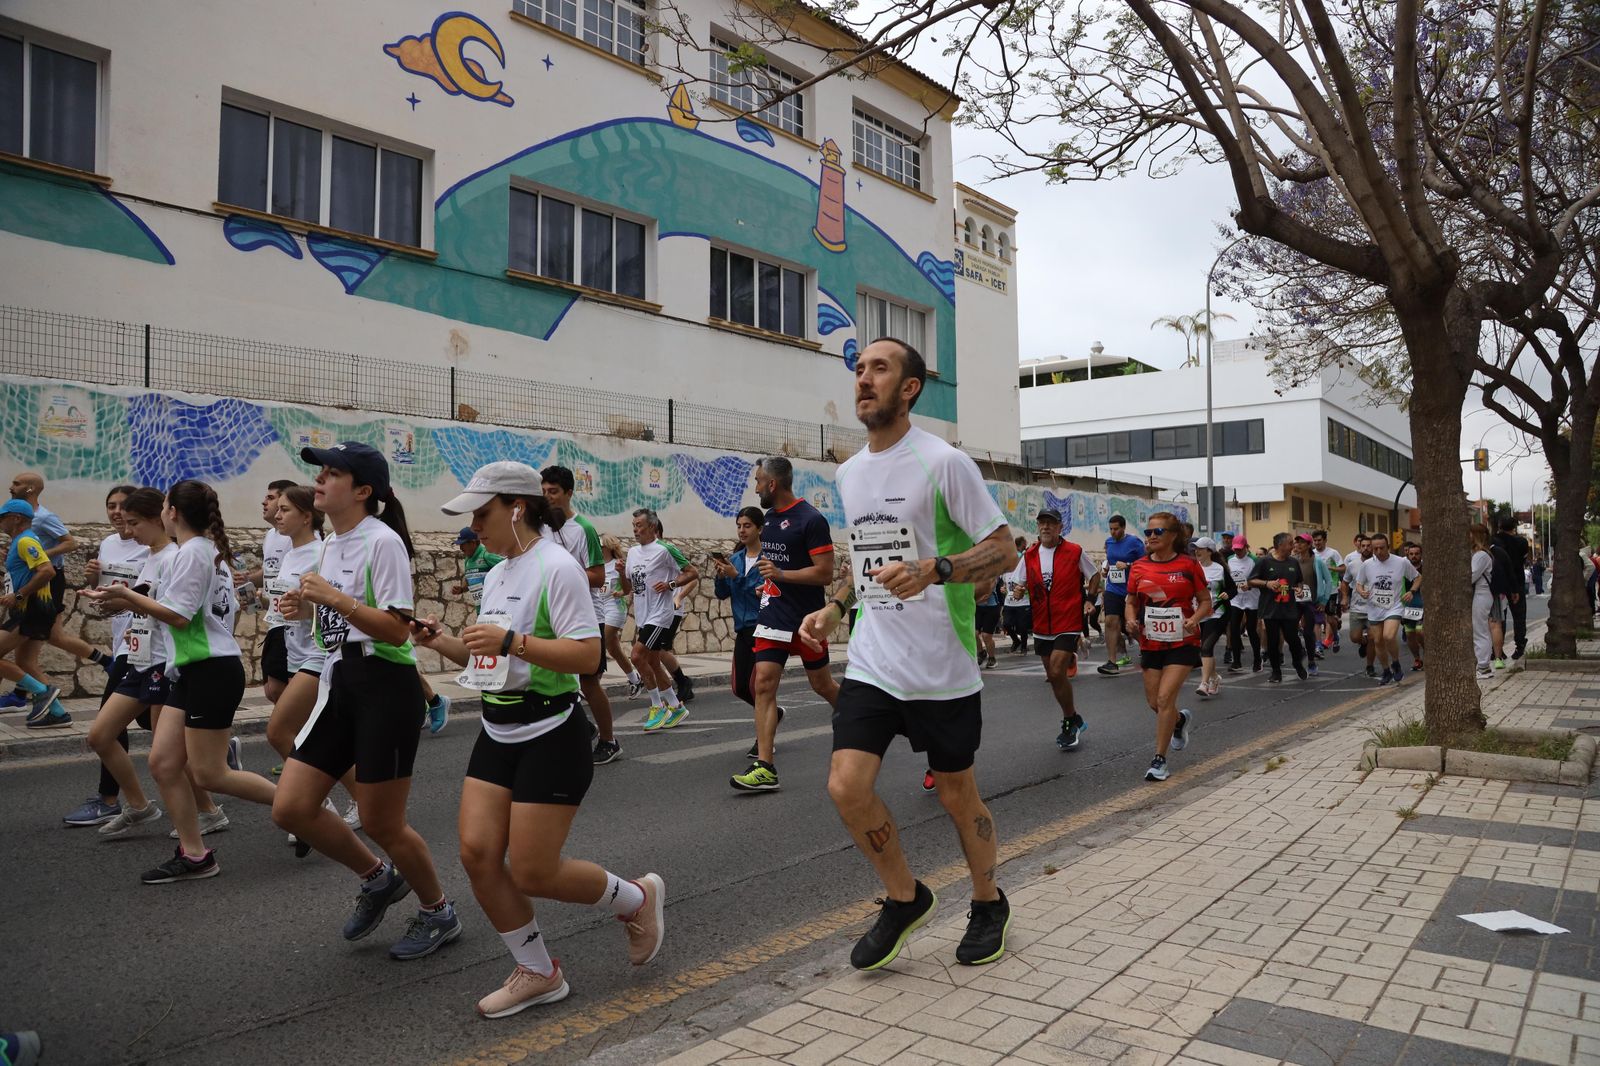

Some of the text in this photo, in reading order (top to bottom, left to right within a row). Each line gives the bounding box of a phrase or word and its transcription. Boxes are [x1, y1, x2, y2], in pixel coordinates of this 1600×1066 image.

[965, 267, 983, 282] SAFA
[991, 277, 1005, 291] ICET
[862, 556, 903, 582] 41
[1152, 621, 1176, 633] 301
